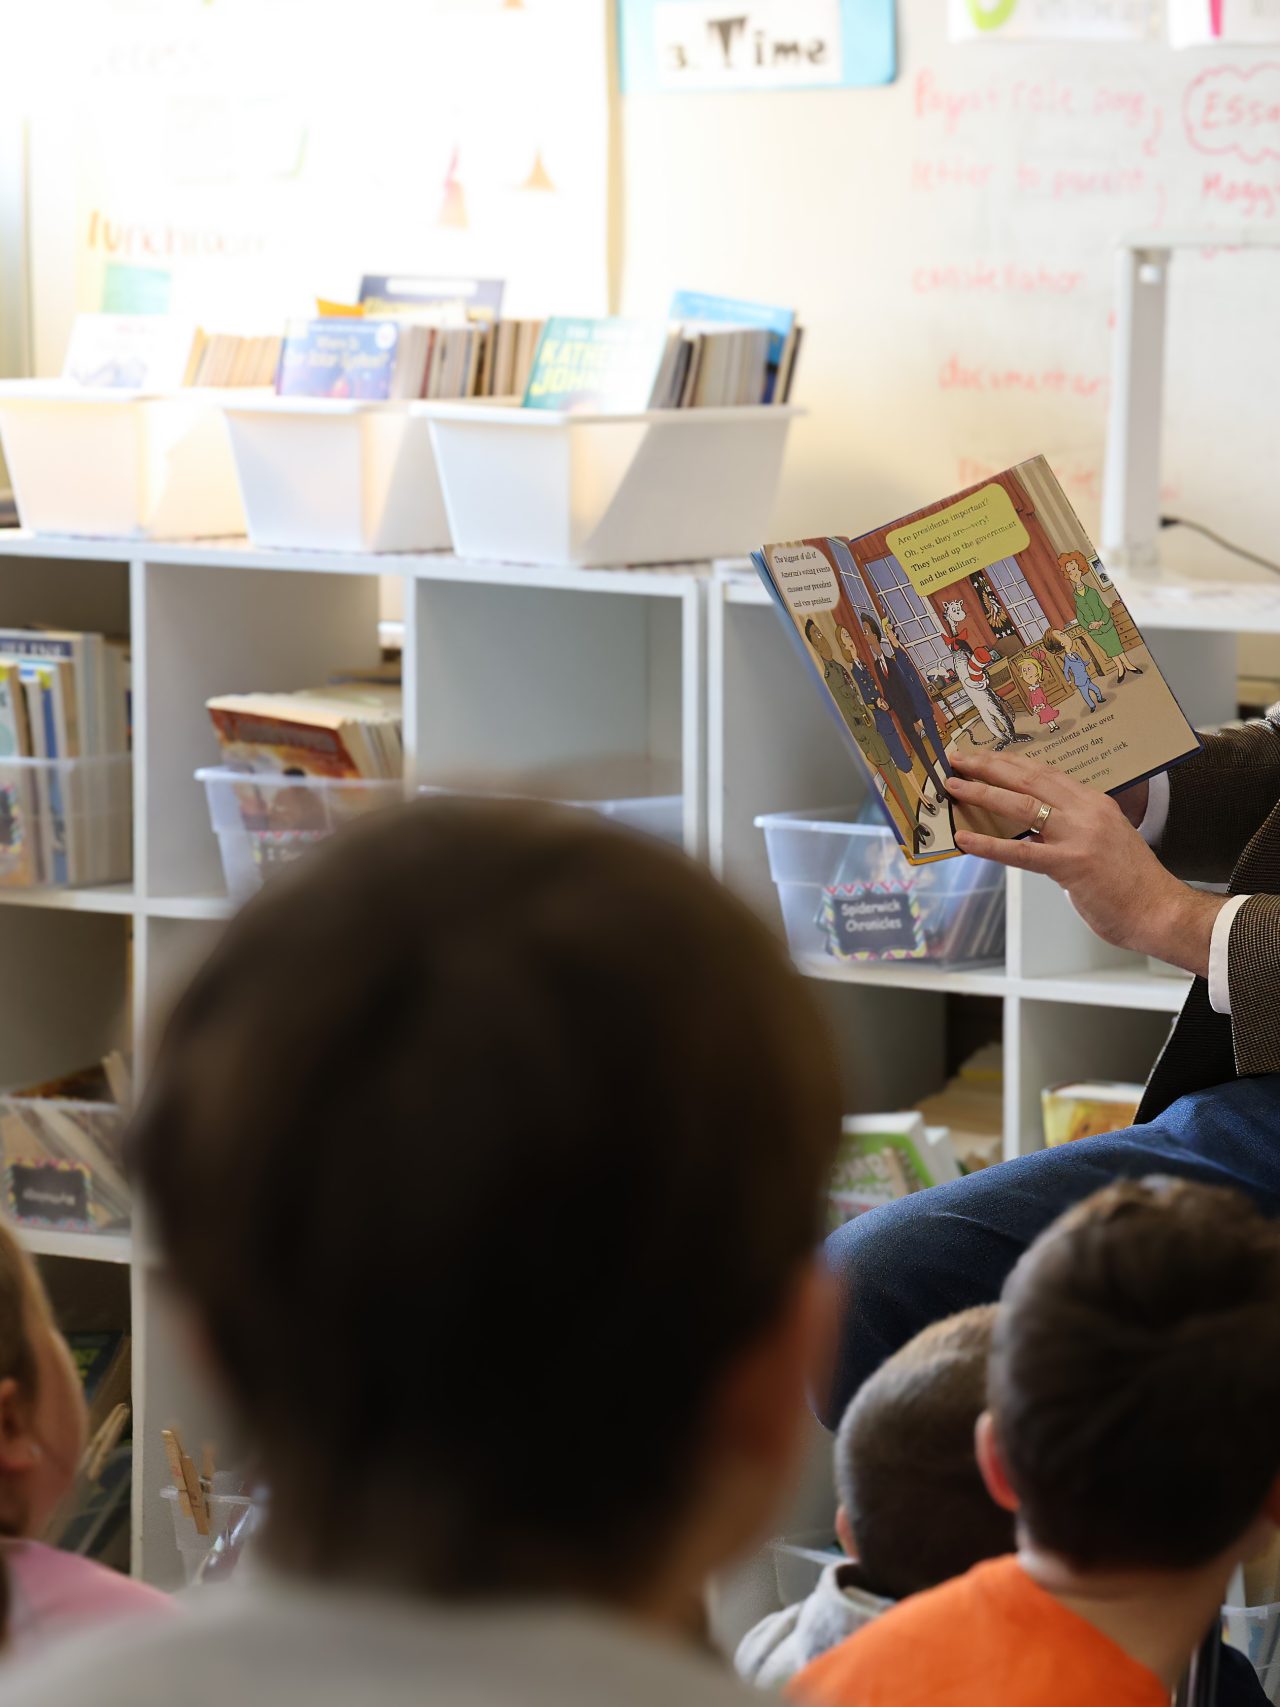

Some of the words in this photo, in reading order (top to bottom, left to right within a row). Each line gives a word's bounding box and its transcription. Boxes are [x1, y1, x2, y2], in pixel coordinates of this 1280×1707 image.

[706, 16, 826, 69] Time
[898, 534, 911, 545] Are
[912, 518, 949, 540] presidents
[951, 498, 990, 520] important?
[911, 559, 931, 573] They
[932, 550, 949, 564] head
[951, 546, 961, 558] up
[962, 539, 974, 551] the
[975, 521, 1017, 546] government
[935, 533, 952, 547] they
[919, 574, 934, 587] and
[935, 568, 947, 579] the
[948, 556, 979, 573] military.
[1025, 748, 1042, 759] Vice
[1043, 730, 1080, 753] presidents
[1081, 721, 1098, 734] take
[1099, 713, 1115, 725] over
[1057, 742, 1089, 762] unhappy
[1090, 736, 1103, 747] day
[1100, 748, 1111, 761] get
[1113, 740, 1129, 753] sick
[841, 899, 901, 917] Spiderwick
[845, 916, 902, 933] Chronicles
